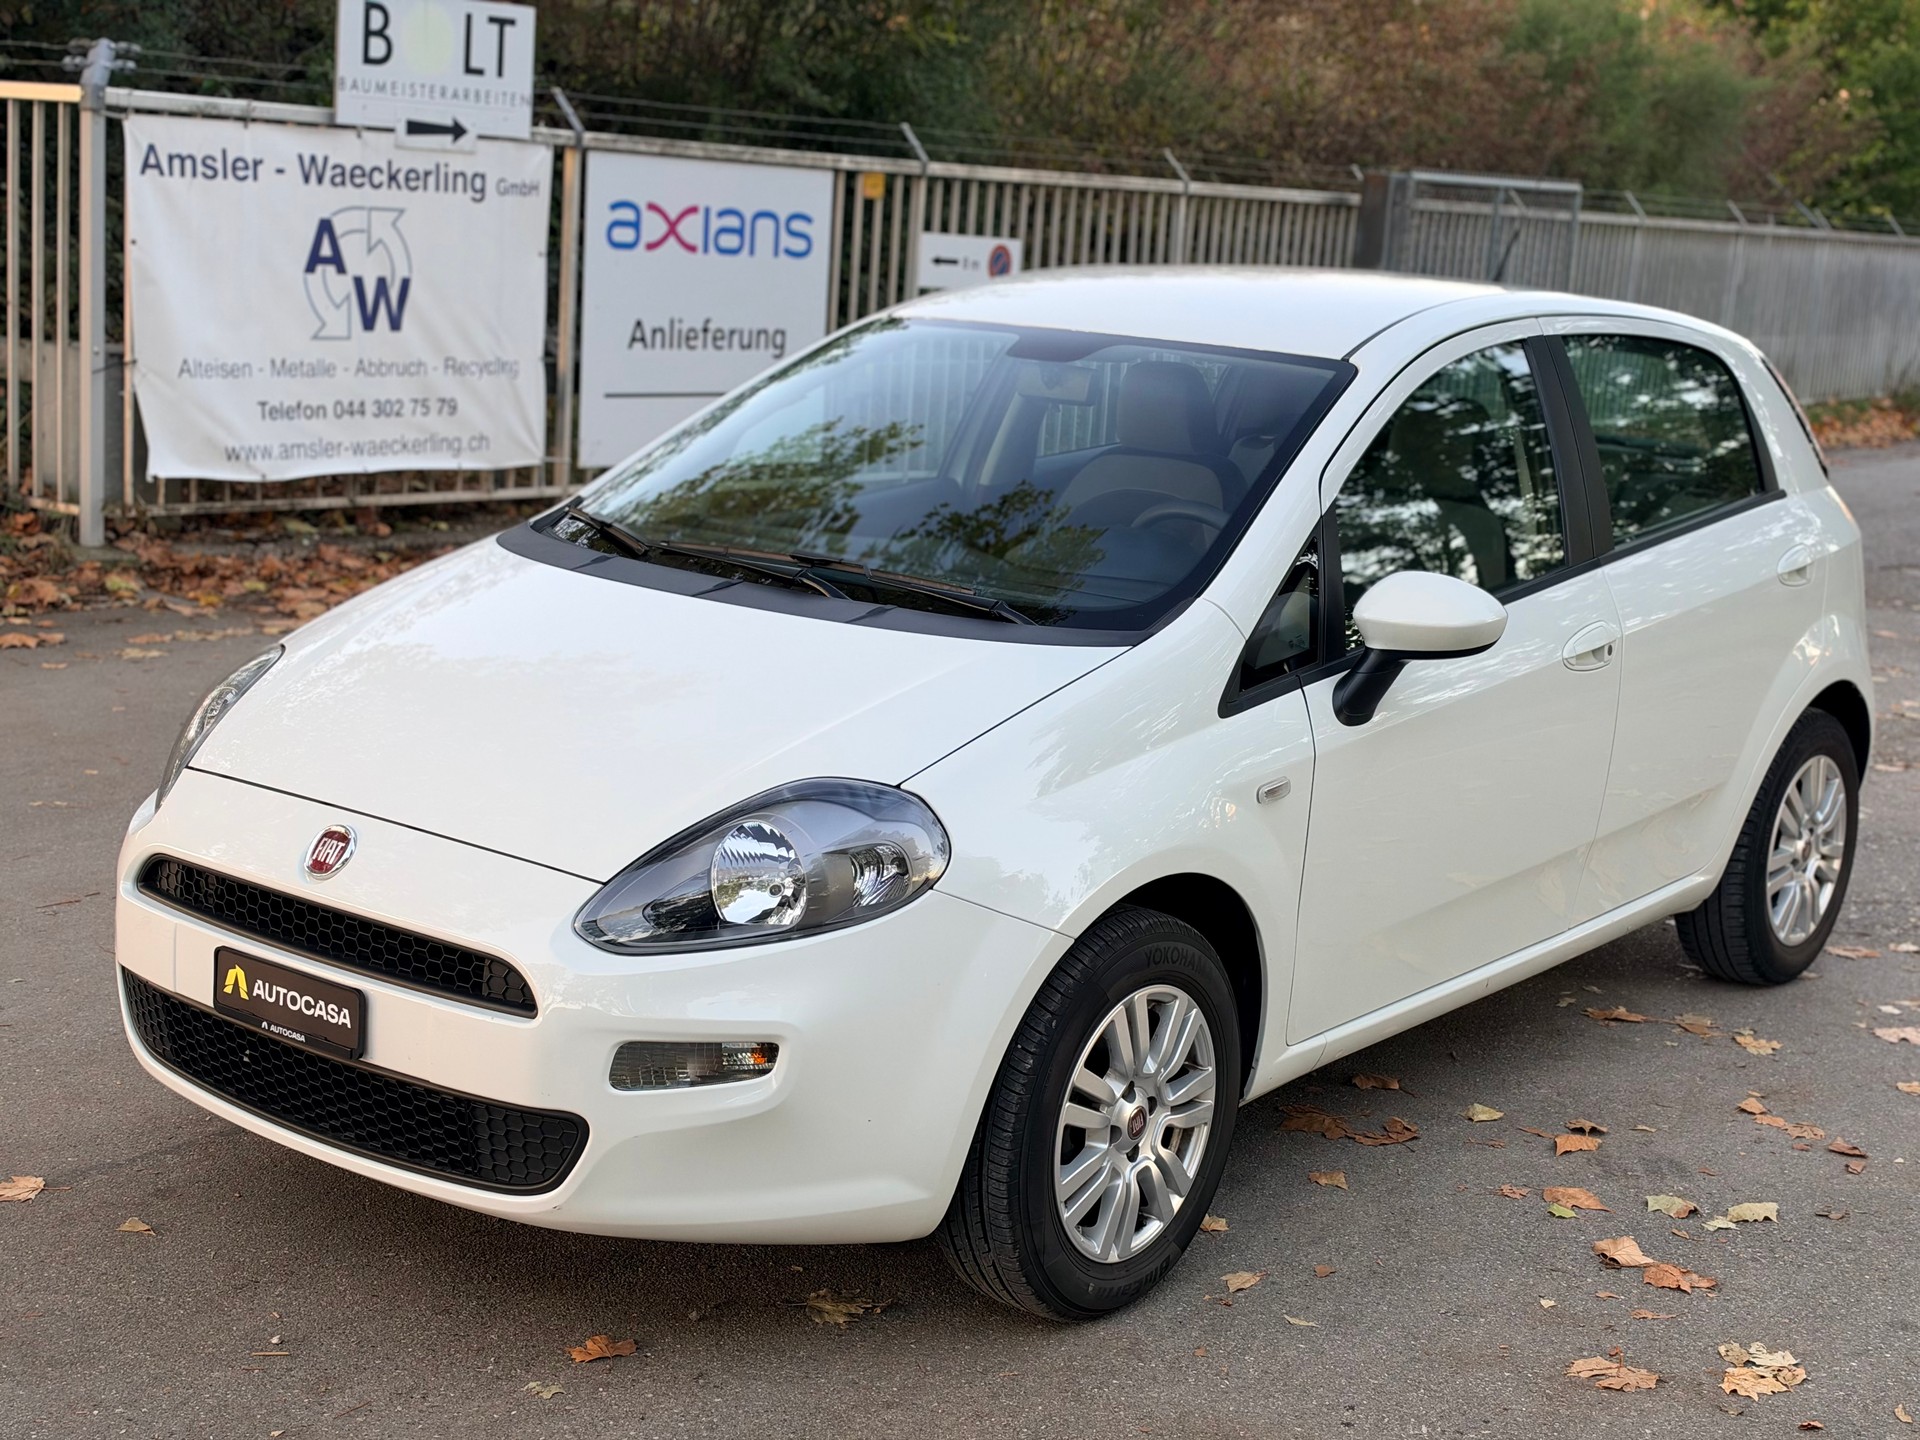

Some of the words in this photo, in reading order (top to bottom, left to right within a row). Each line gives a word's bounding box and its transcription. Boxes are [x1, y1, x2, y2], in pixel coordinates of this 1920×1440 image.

[338, 76, 531, 108] BAUMEISTERARBEITEN
[140, 143, 265, 182] Amsler
[297, 153, 487, 202] Waeckerling
[496, 178, 540, 198] GmbH
[606, 200, 814, 259] axians
[628, 317, 787, 358] Anlieferung
[178, 358, 254, 379] Alteisen
[270, 359, 336, 379] Metalle
[354, 358, 428, 377] Abbruch
[444, 356, 520, 380] Recycling
[257, 400, 327, 421] Telefon
[333, 399, 366, 419] 044
[371, 399, 405, 419] 302
[409, 398, 431, 418] 75
[436, 398, 458, 417] 79
[225, 432, 490, 461] www.amsler-waeckerling.ch
[313, 837, 346, 866] FIAT
[1144, 946, 1205, 975] YOKOHA
[252, 979, 352, 1029] AUTOCASA
[270, 1024, 306, 1043] AUTOCASA
